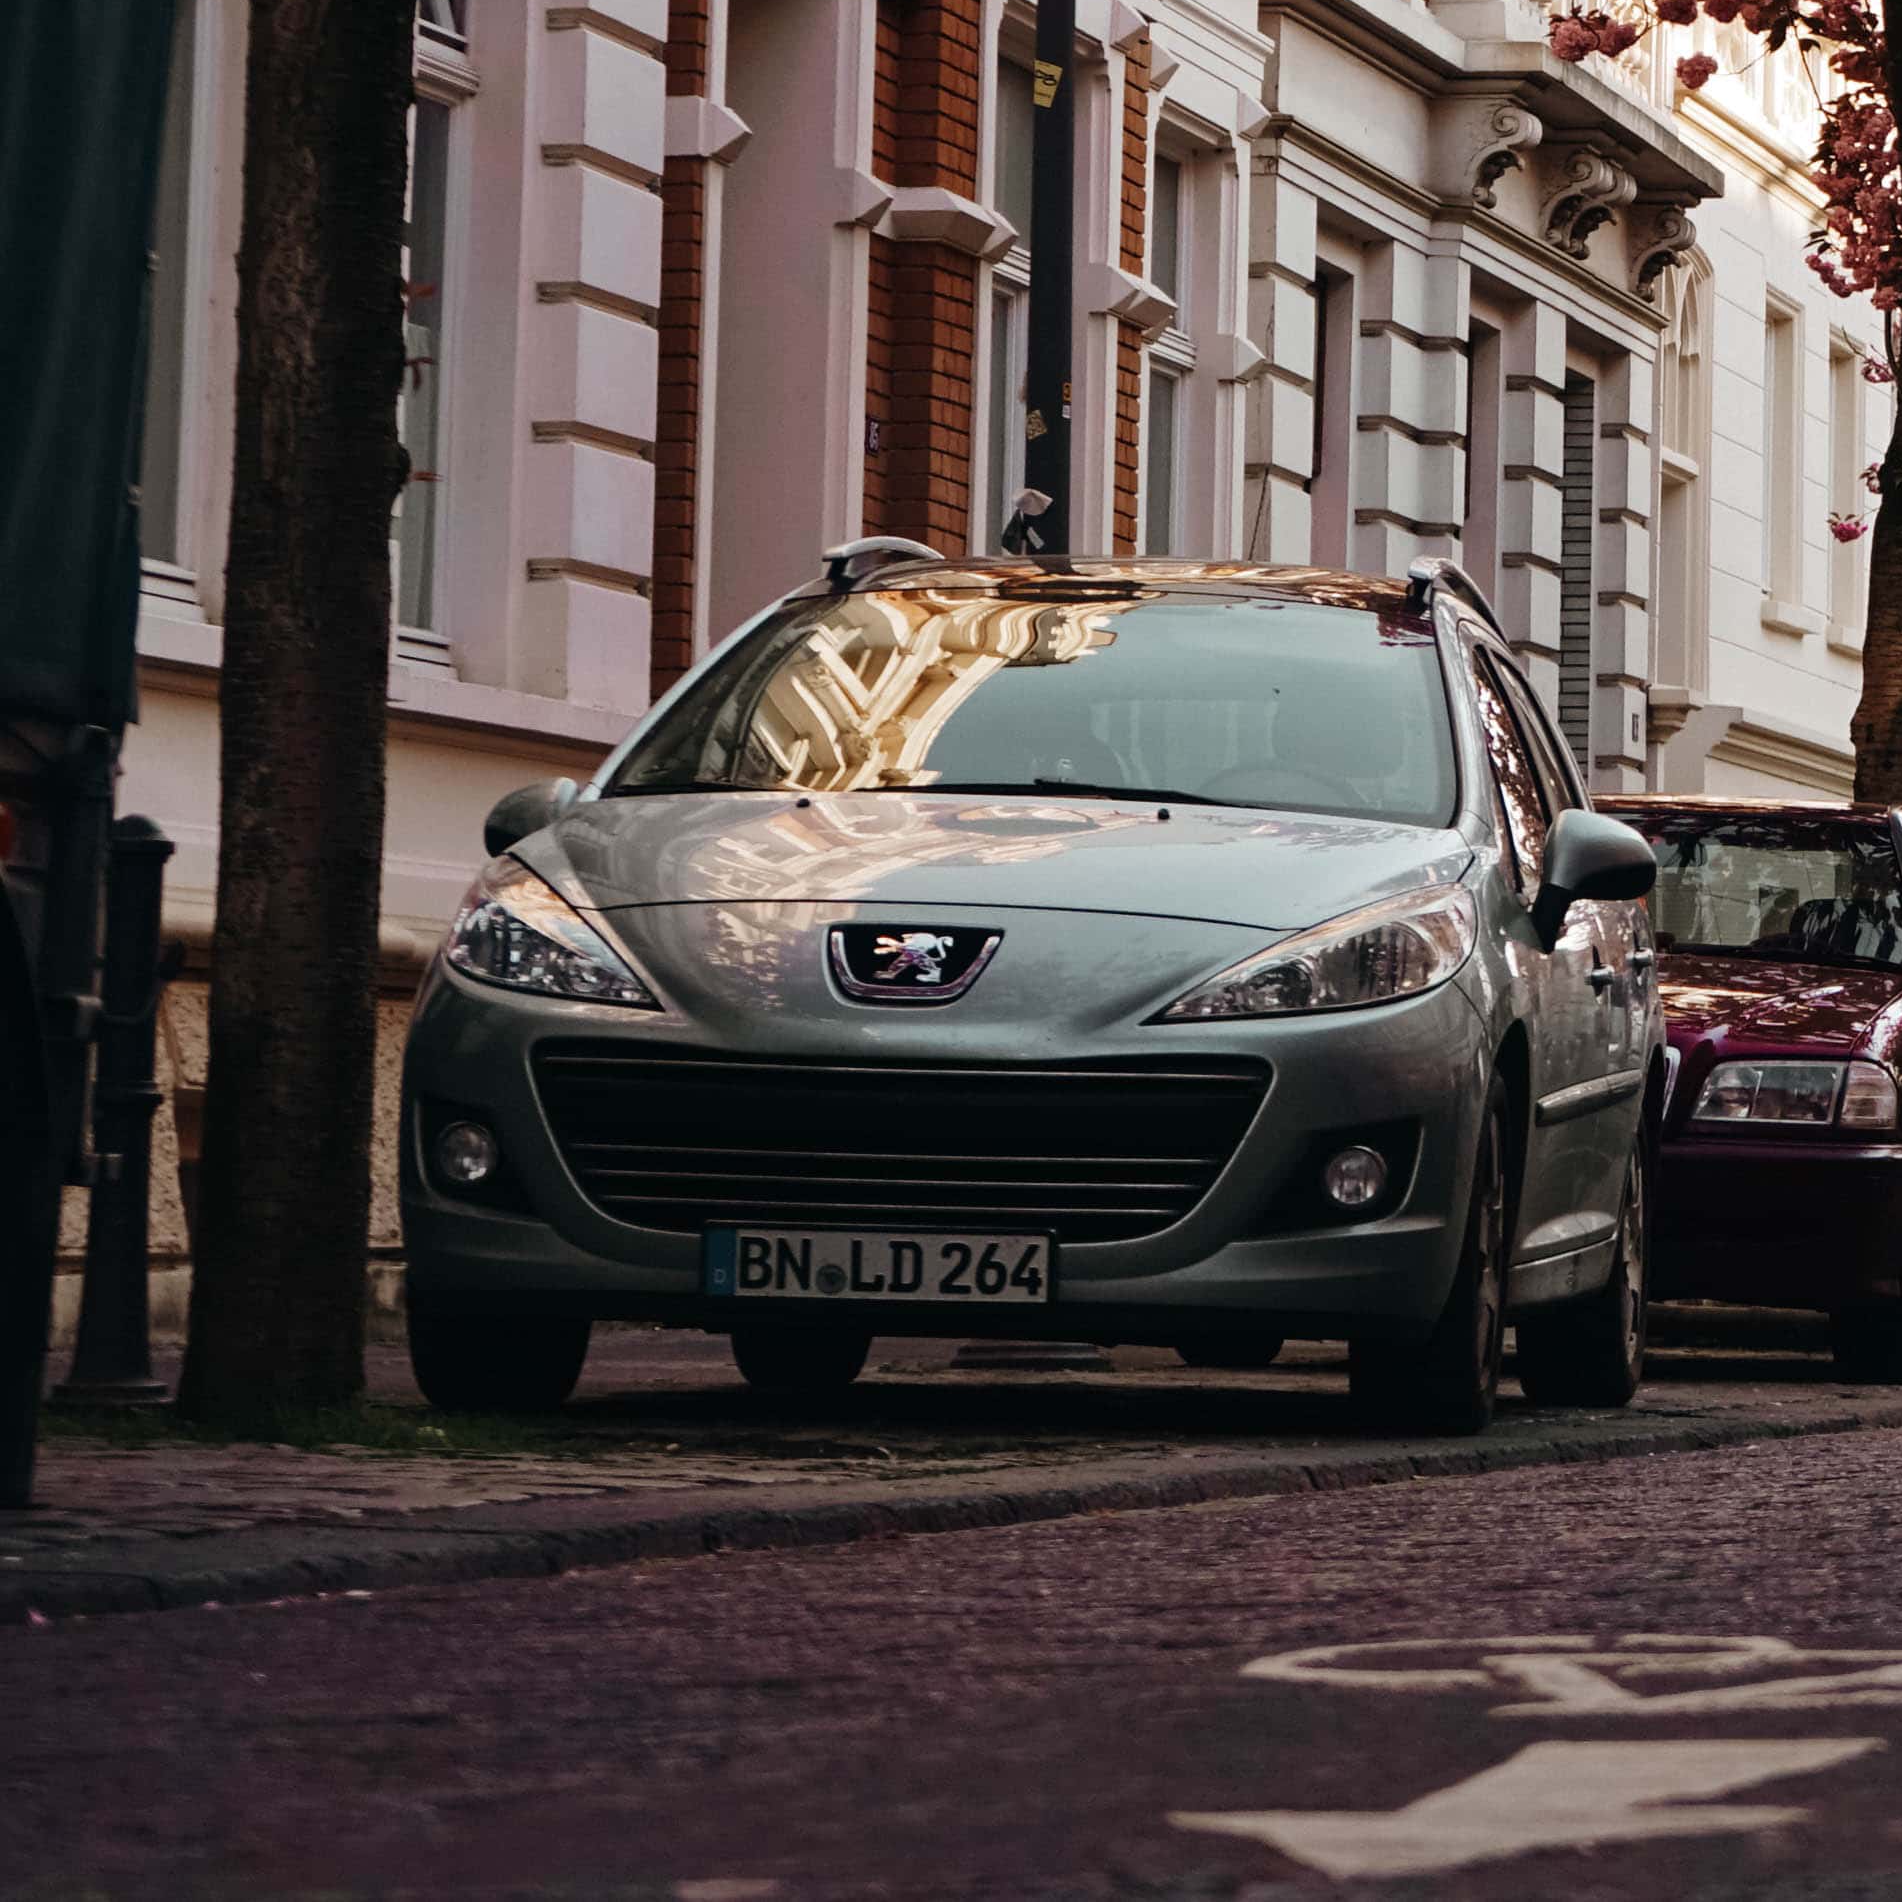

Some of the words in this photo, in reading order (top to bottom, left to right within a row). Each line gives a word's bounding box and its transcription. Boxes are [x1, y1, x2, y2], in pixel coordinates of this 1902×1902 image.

[739, 1236, 812, 1291] BN
[851, 1239, 923, 1293] LD
[939, 1242, 1043, 1296] 264
